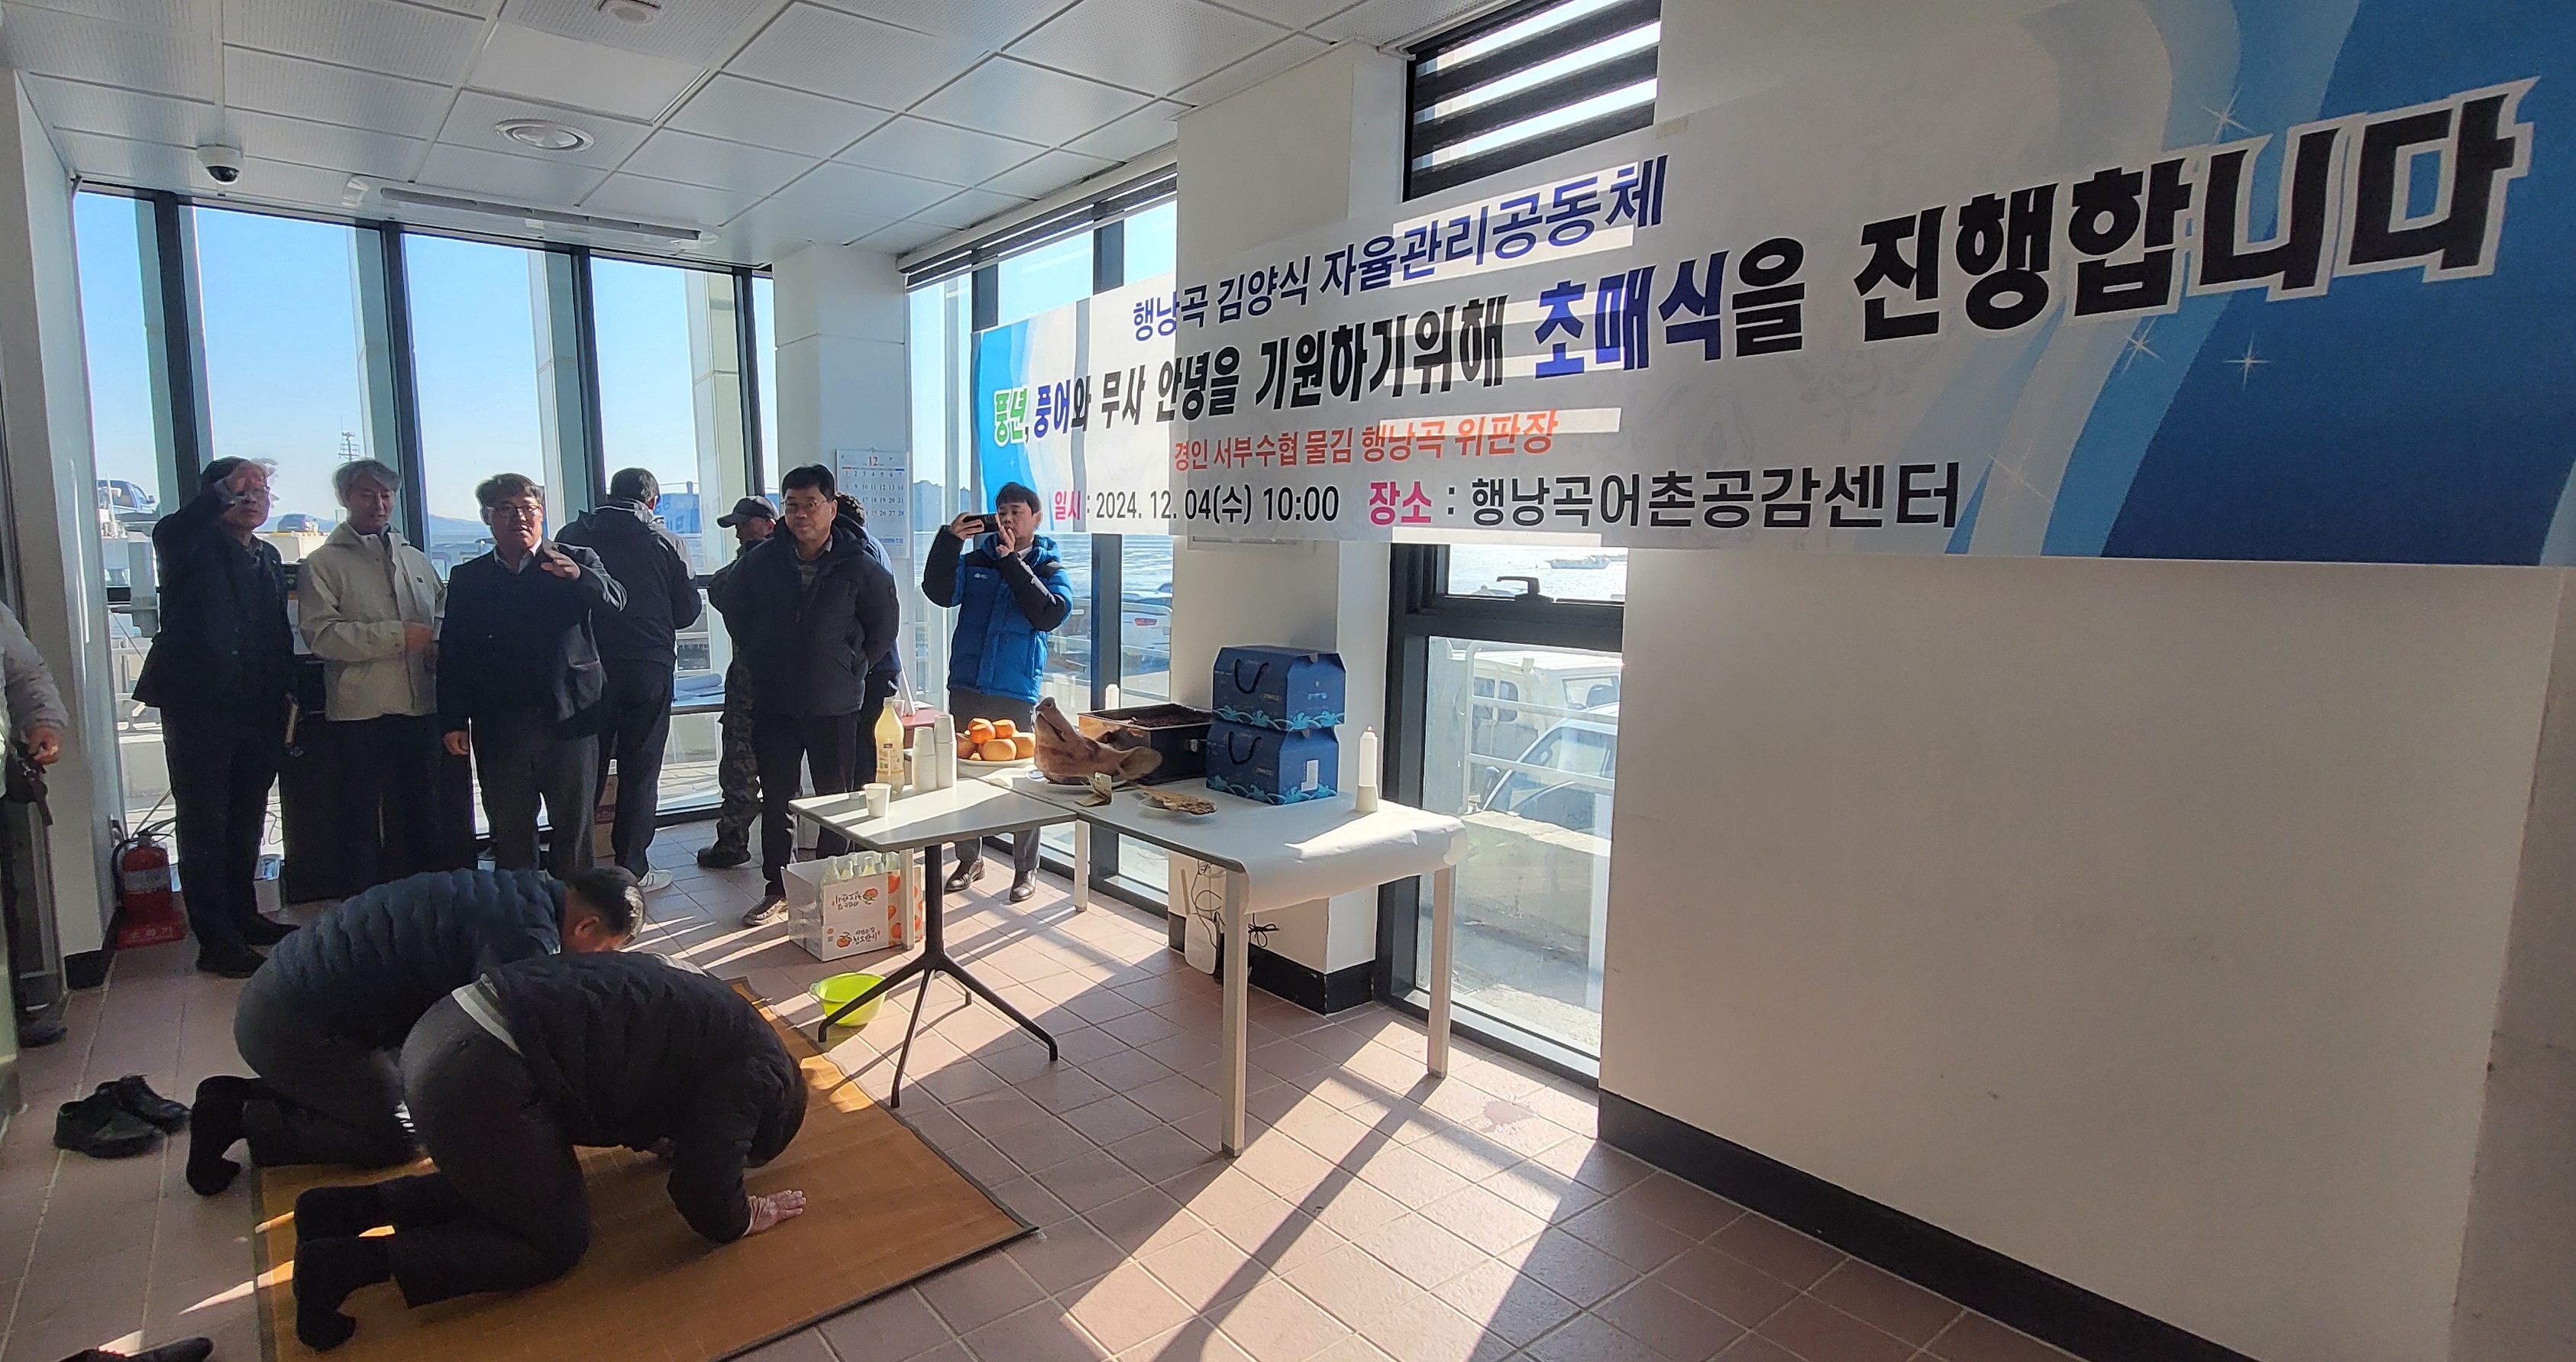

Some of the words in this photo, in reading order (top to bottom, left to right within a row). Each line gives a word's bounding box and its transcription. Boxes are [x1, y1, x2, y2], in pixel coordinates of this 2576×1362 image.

[994, 387, 1029, 444] 풍년,
[1034, 374, 1092, 438] 풍어와
[1101, 364, 1145, 429] 무사
[1155, 345, 1242, 422] 안녕을
[1256, 295, 1508, 410] 기원하기위해
[1534, 237, 1808, 380] 초매식을
[1851, 82, 2529, 344] 진행합니다
[1133, 284, 1209, 342] 행낭곡
[1217, 255, 1311, 325] 김양식
[1320, 154, 1669, 296] 자율관리공동체
[868, 456, 878, 467] 12
[1174, 438, 1208, 472] 경인
[1213, 431, 1298, 471] 서부수협
[1304, 427, 1353, 465] 물김
[1362, 421, 1445, 461] 행낭곡
[1456, 409, 1560, 458] 위판장
[1054, 490, 1082, 521] 일시
[1096, 490, 1143, 519] 2024.
[1150, 490, 1178, 520] 12.
[1185, 484, 1252, 525] 04(수)
[1262, 485, 1340, 522] 10:00
[1369, 481, 1433, 526] 장소
[1471, 461, 1961, 529] 행낭곡어촌공감센터
